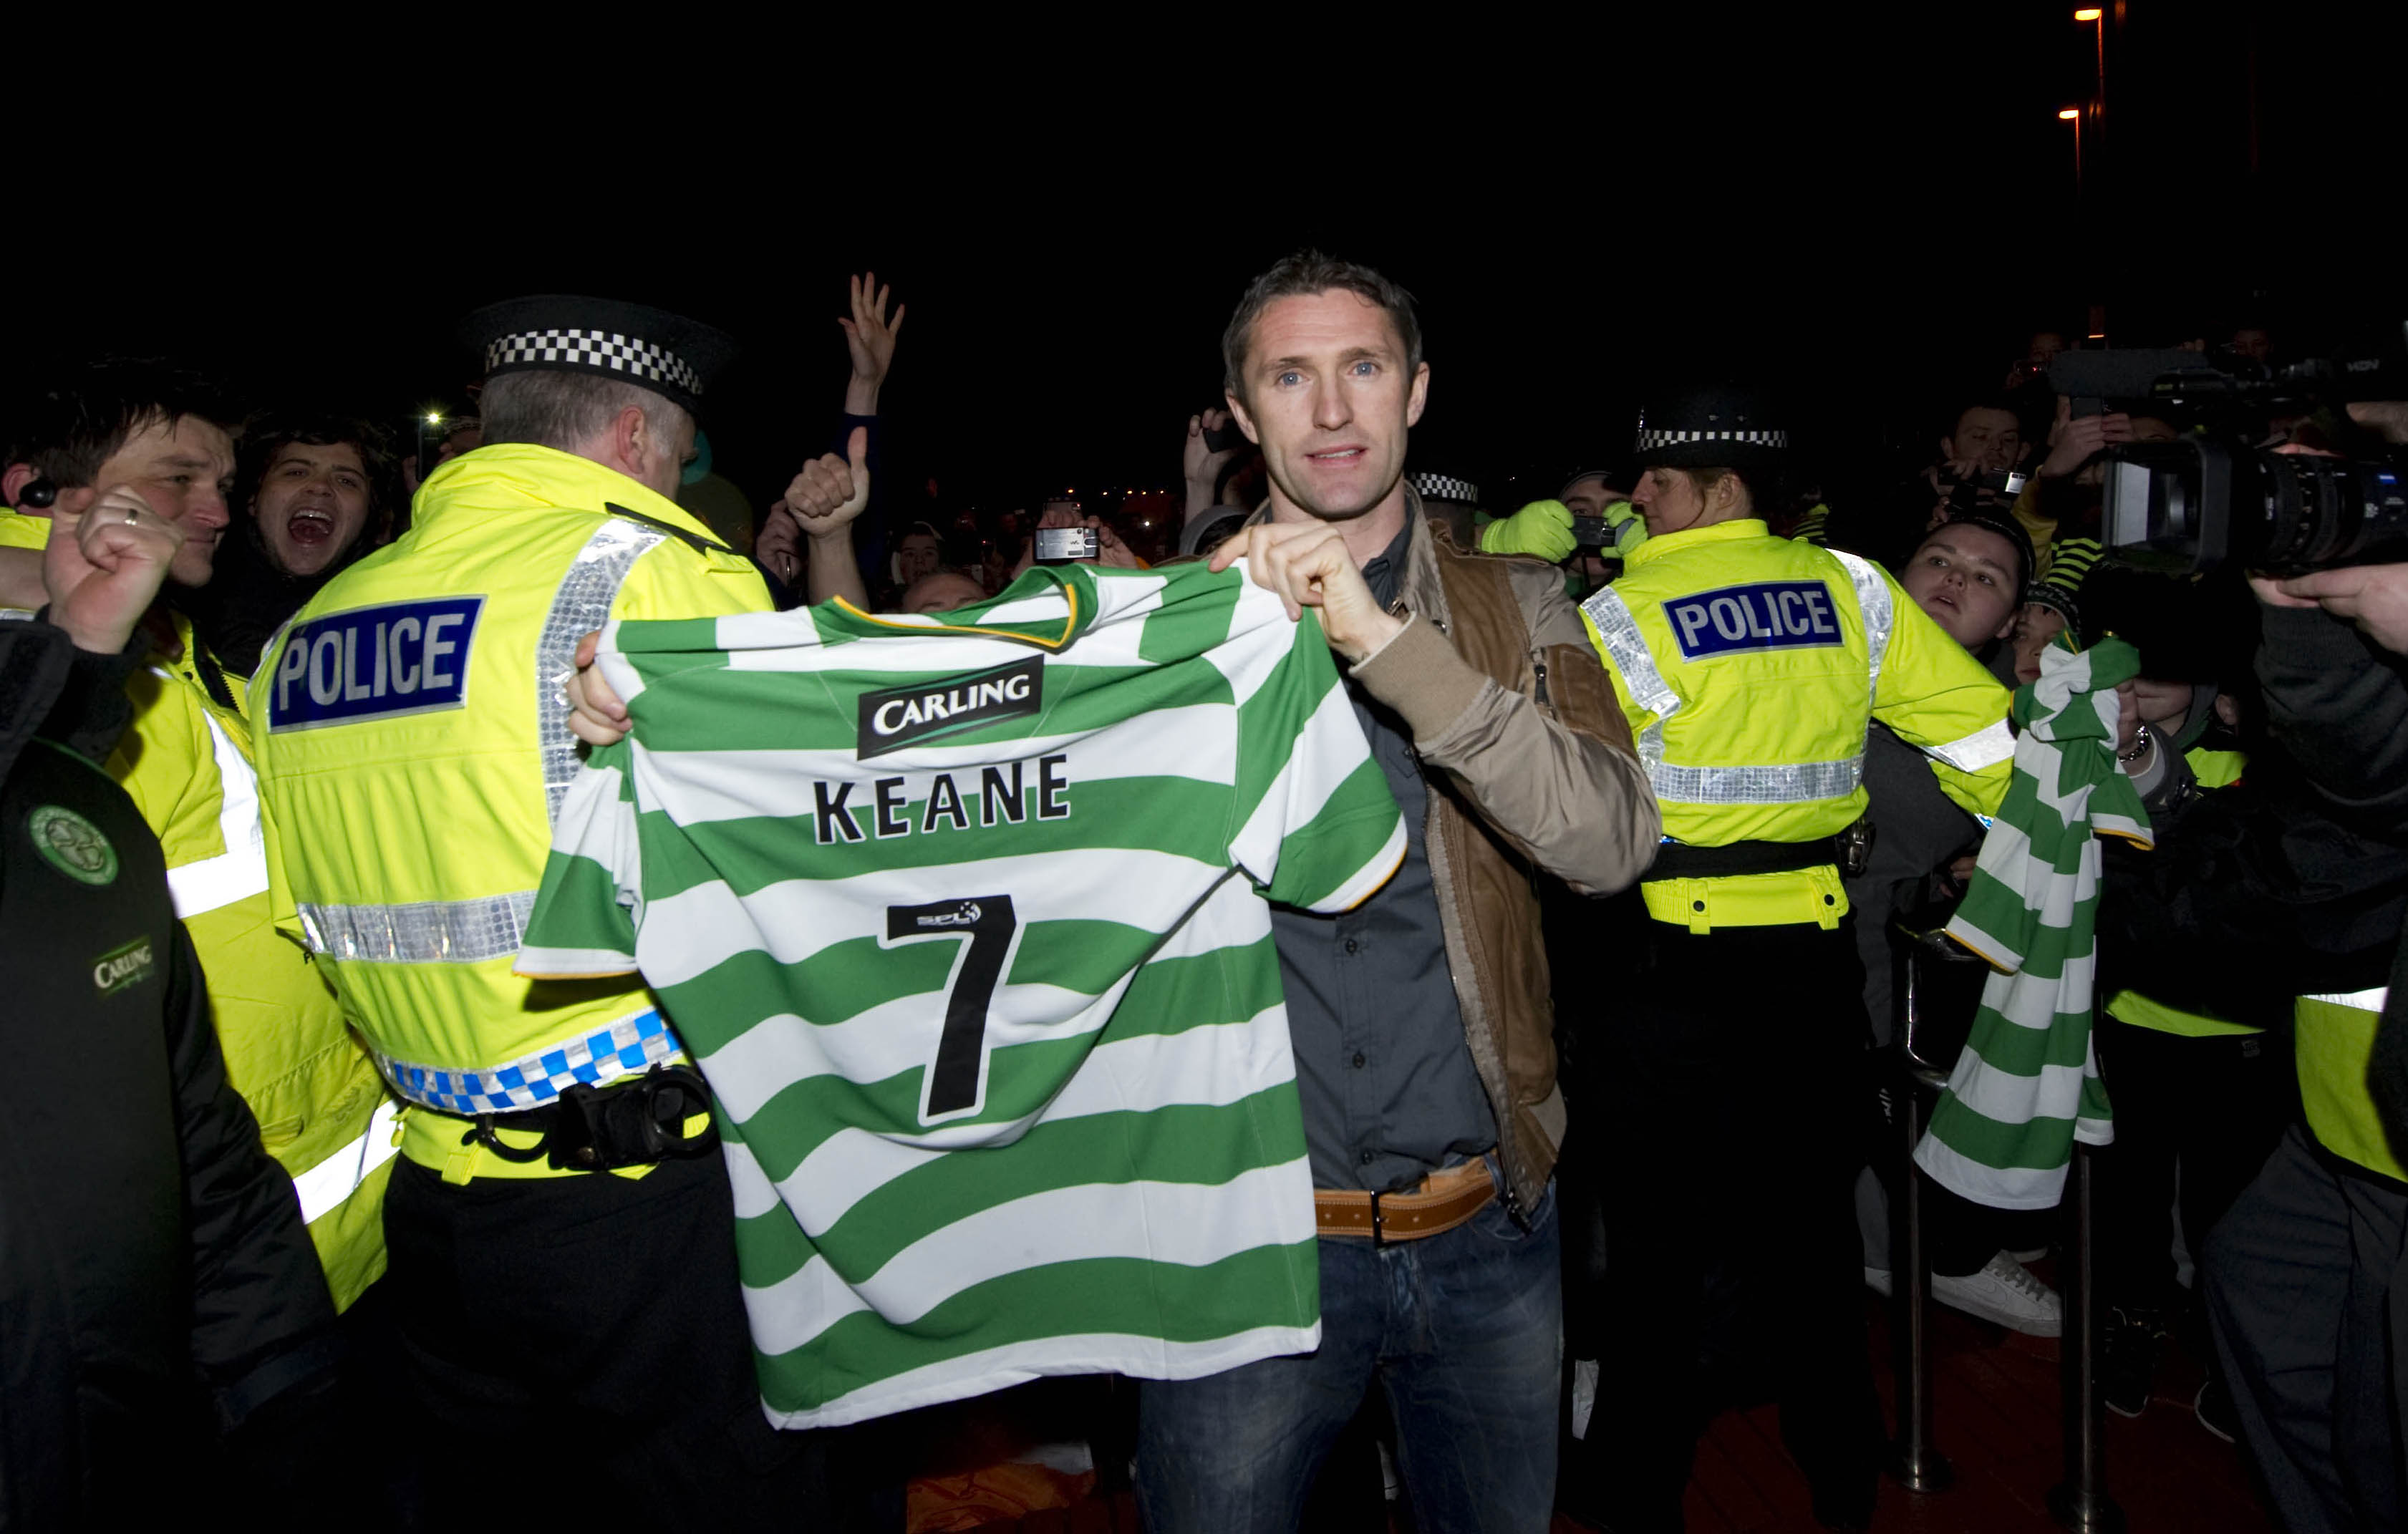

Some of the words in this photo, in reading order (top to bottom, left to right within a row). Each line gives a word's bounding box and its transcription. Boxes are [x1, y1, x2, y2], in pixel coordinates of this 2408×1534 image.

[278, 613, 465, 711] POLICE
[1675, 591, 1834, 647] POLICE
[872, 674, 1030, 735] CARLING
[813, 753, 1070, 845] KEANE
[879, 893, 1018, 1123] 7
